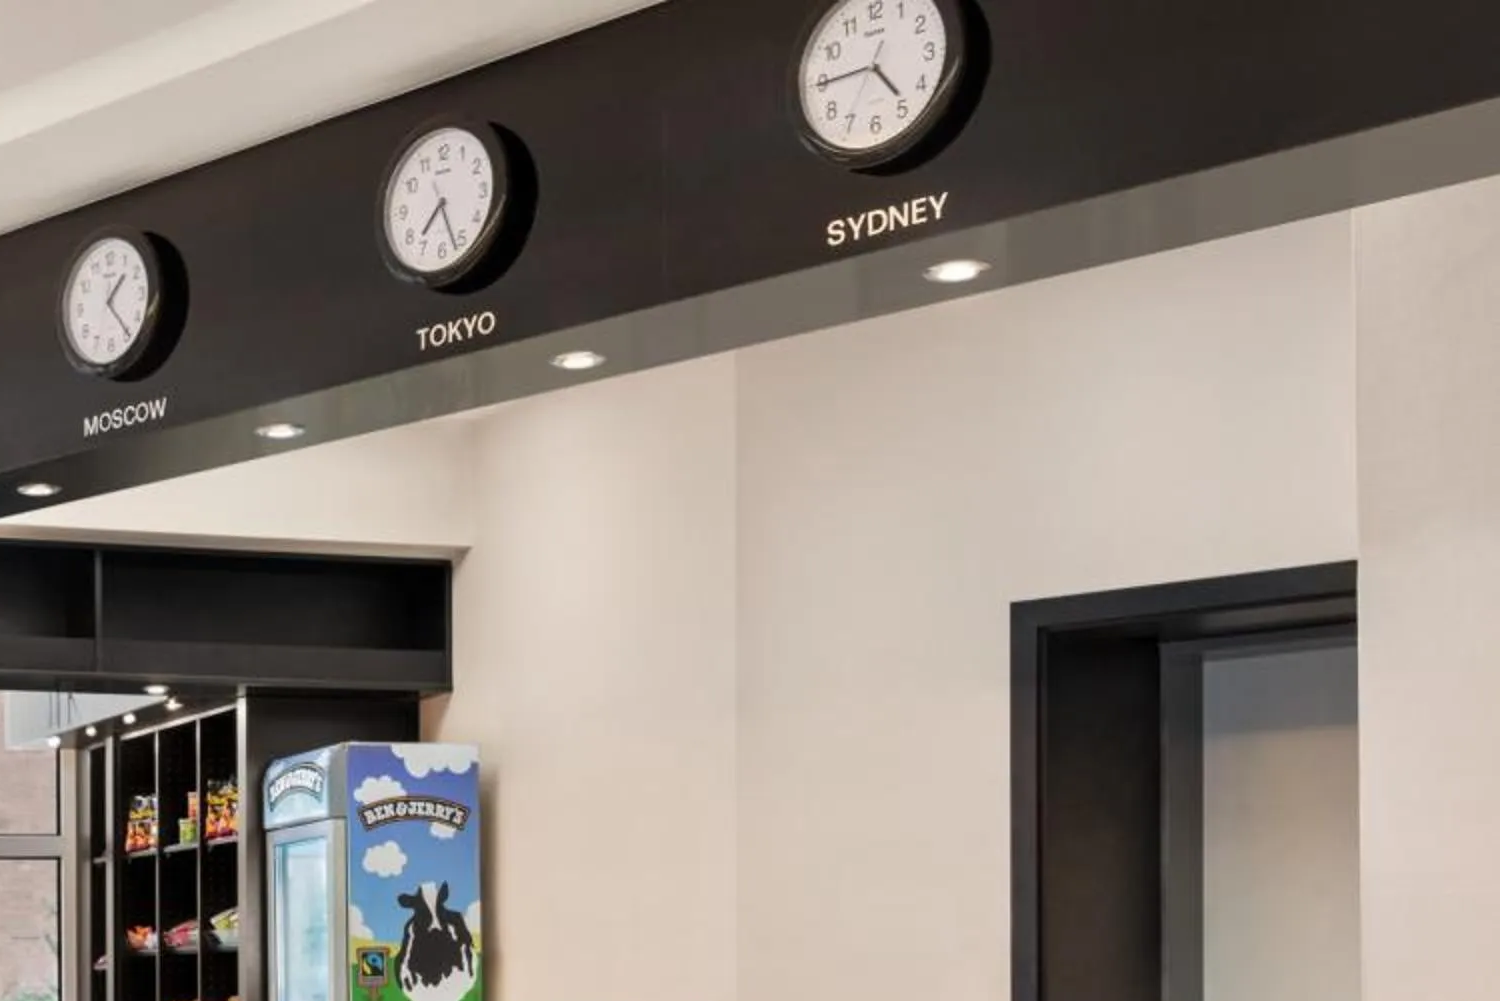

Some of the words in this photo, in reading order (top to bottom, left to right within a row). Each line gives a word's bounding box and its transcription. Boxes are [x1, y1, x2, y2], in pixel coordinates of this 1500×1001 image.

[826, 191, 949, 246] SYDNEY
[415, 311, 496, 351] TOKYO
[83, 397, 167, 438] MOSCOW
